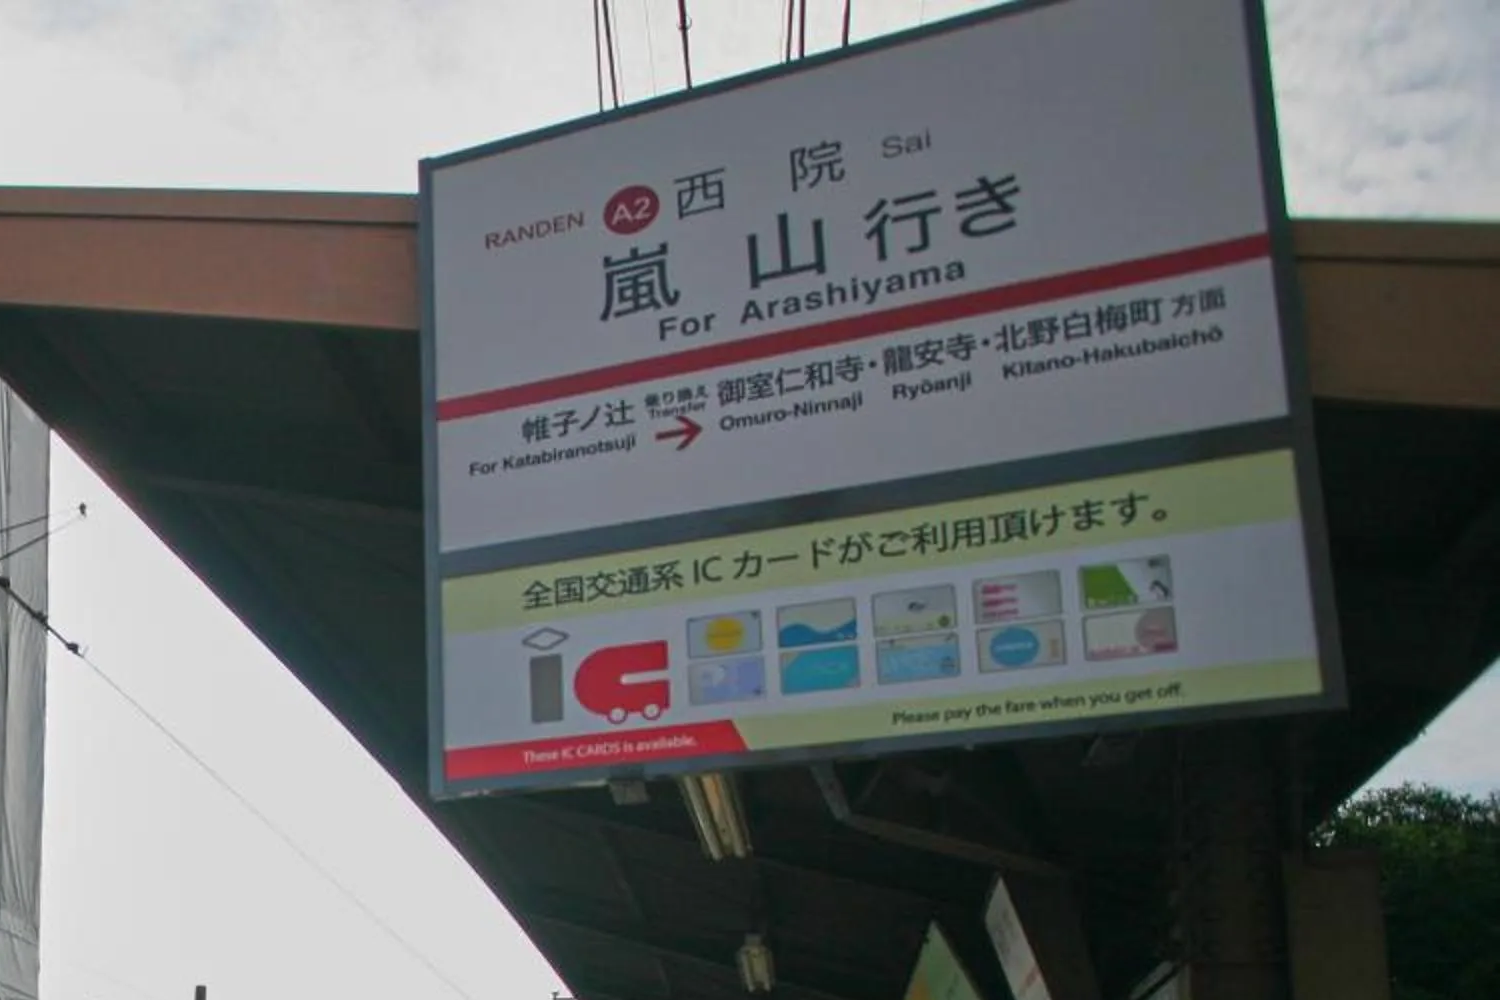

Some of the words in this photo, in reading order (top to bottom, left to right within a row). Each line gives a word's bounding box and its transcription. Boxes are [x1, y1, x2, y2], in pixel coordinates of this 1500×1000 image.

[882, 128, 931, 159] Sai
[612, 196, 651, 225] A2
[485, 211, 584, 249] RANDEN
[659, 313, 716, 341] For
[740, 259, 965, 324] Arashiyama
[649, 401, 706, 420] Transfer
[719, 391, 863, 431] Omuro-Ninnaji
[469, 460, 497, 476] For
[503, 434, 636, 471] Katabiranotsuji
[892, 709, 940, 726] Please
[943, 706, 973, 723] pay
[975, 701, 1001, 717] the
[1005, 697, 1036, 714] fare
[1039, 693, 1086, 711] when
[1089, 692, 1122, 709] you
[1124, 687, 1153, 704] get
[523, 750, 558, 765] These
[576, 742, 621, 758] CARDS
[623, 739, 634, 753] is
